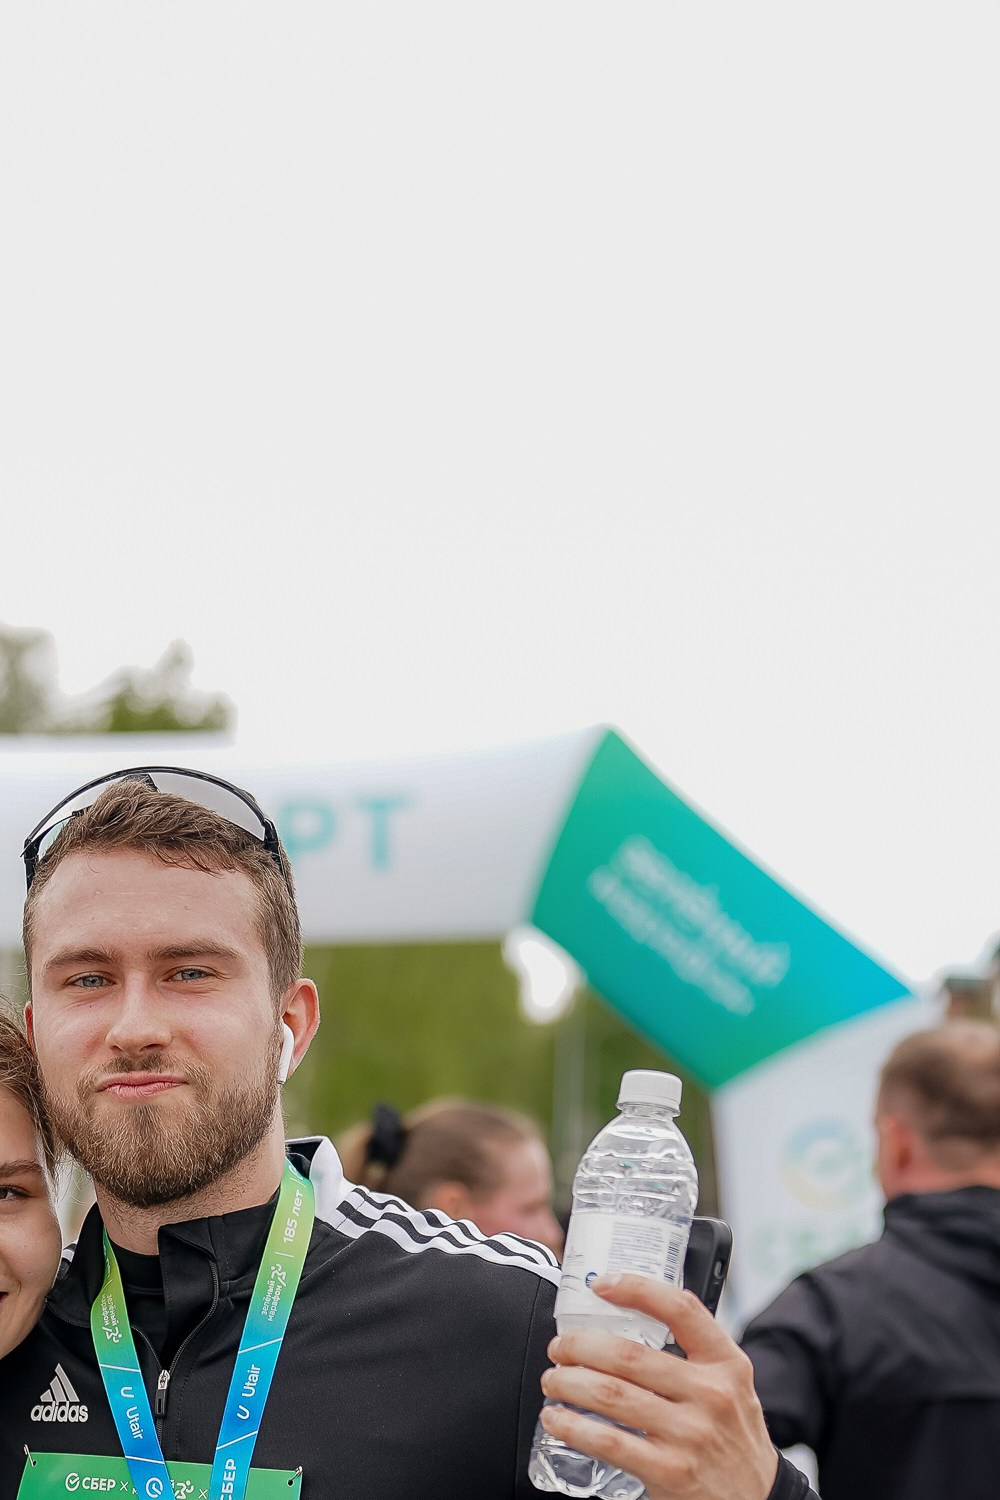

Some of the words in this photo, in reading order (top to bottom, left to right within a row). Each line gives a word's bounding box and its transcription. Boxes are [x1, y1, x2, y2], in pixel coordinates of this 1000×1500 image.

[283, 1217, 298, 1243] 185
[292, 1189, 304, 1217] лет
[261, 1280, 276, 1316] зелёный
[268, 1285, 283, 1322] марафон
[241, 1364, 261, 1398] Utair
[30, 1401, 89, 1423] adidas
[126, 1406, 144, 1440] Utair
[81, 1477, 117, 1492] СБЕР
